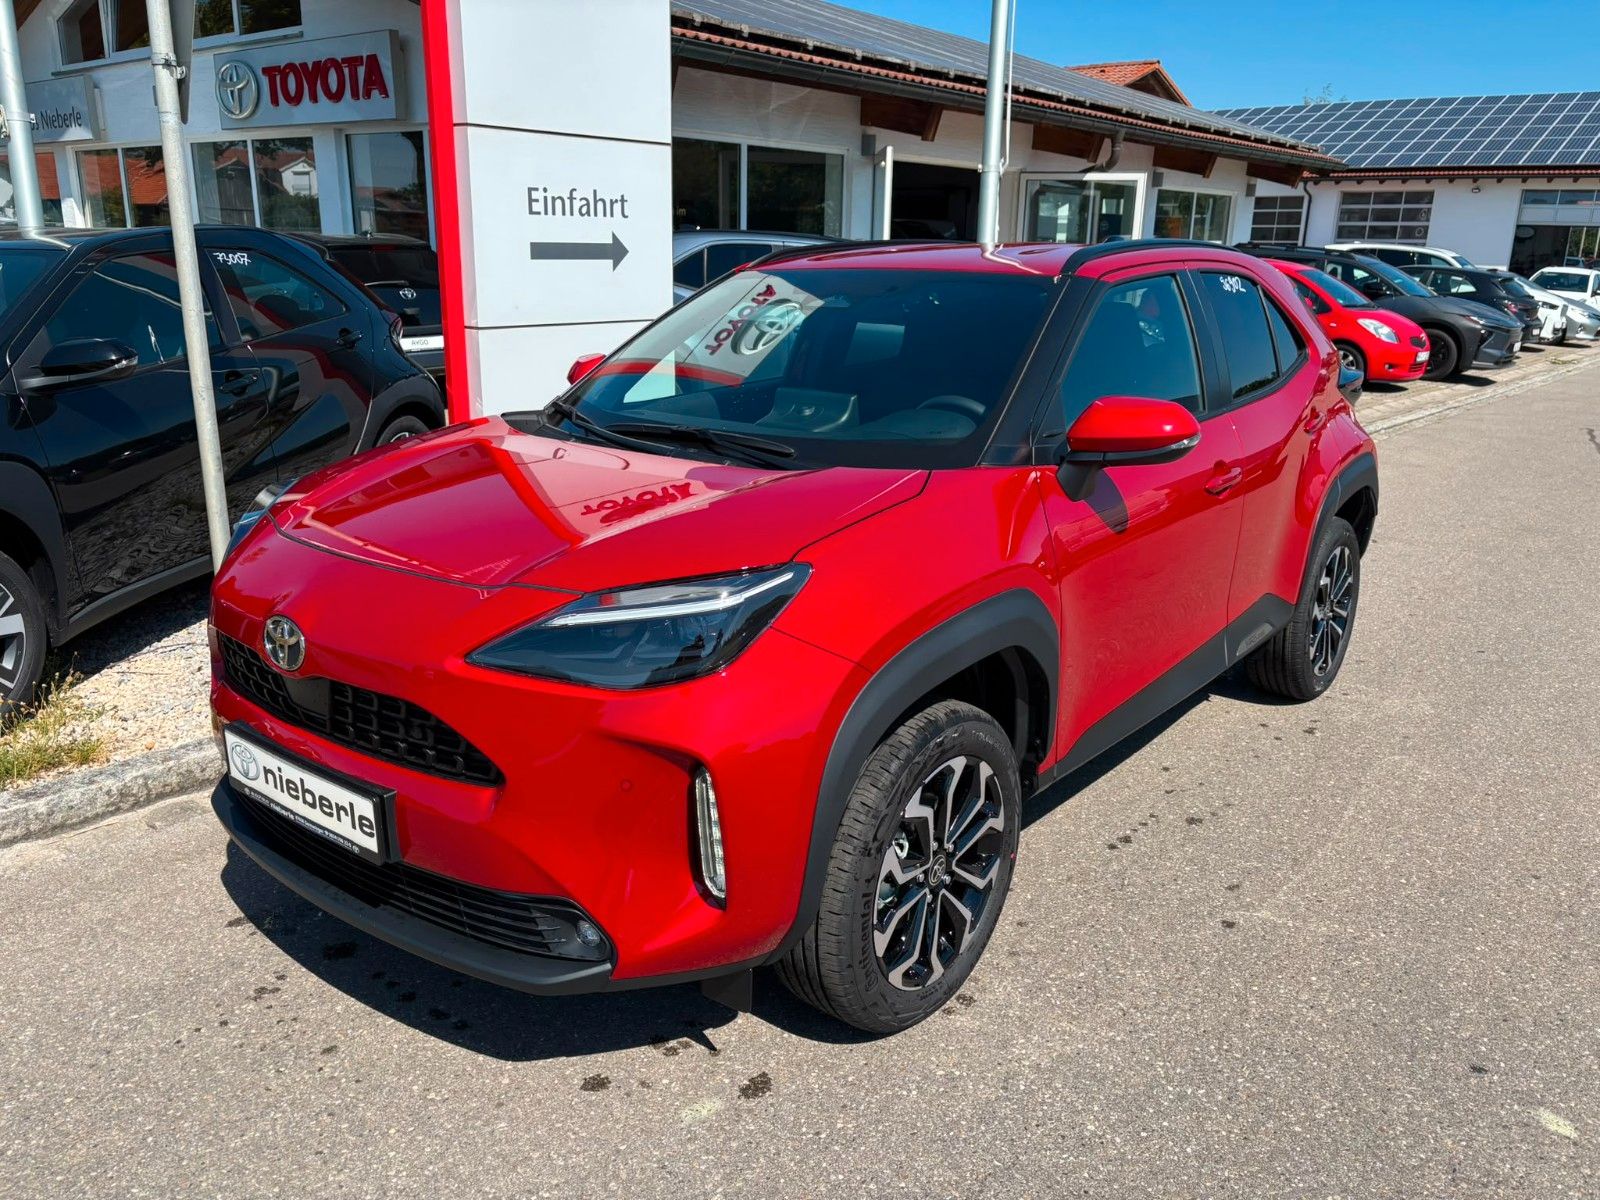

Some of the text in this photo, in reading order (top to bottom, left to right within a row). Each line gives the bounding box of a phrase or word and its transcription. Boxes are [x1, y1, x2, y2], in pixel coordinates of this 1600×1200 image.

[262, 54, 389, 107] TOYOTA
[40, 106, 82, 130] Nieberle
[527, 186, 629, 219] Einfahrt
[263, 765, 375, 838] nieberle
